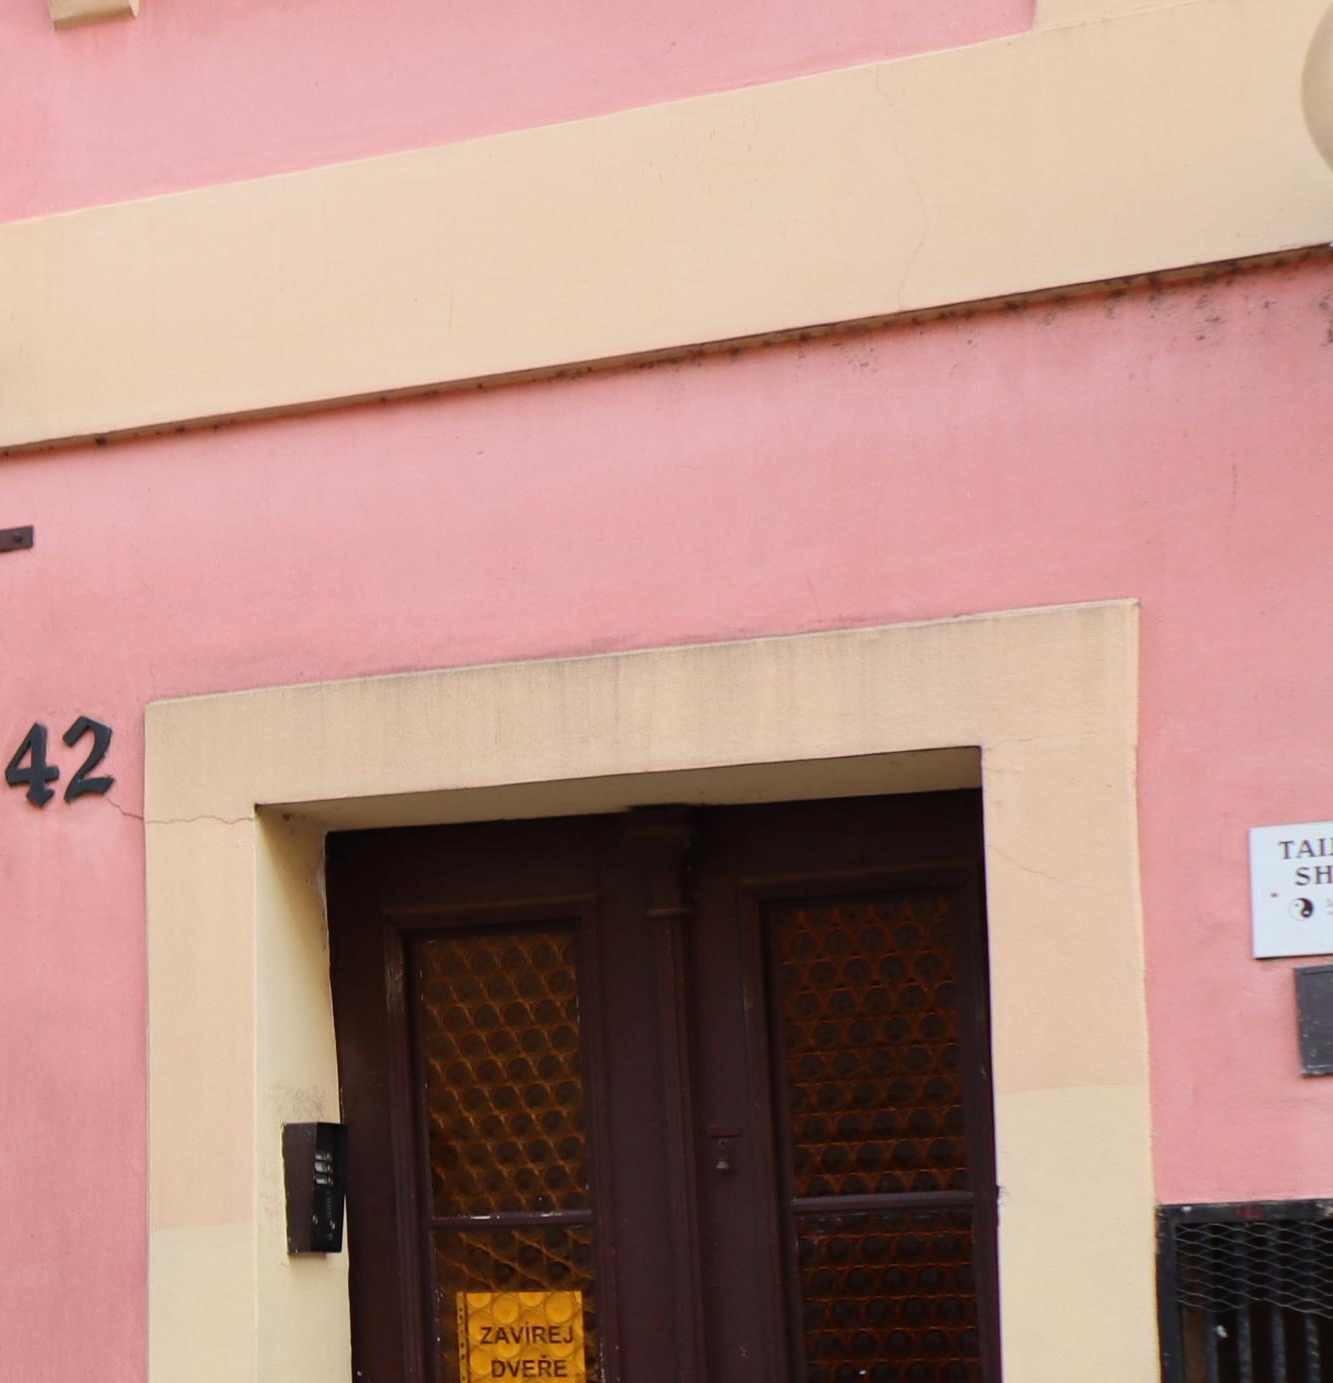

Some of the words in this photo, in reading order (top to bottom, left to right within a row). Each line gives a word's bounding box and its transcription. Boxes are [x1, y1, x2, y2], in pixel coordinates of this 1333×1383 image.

[5, 715, 114, 808] 42
[479, 1321, 575, 1345] ZAVÍREJ
[491, 1355, 568, 1378] DVEŘE
